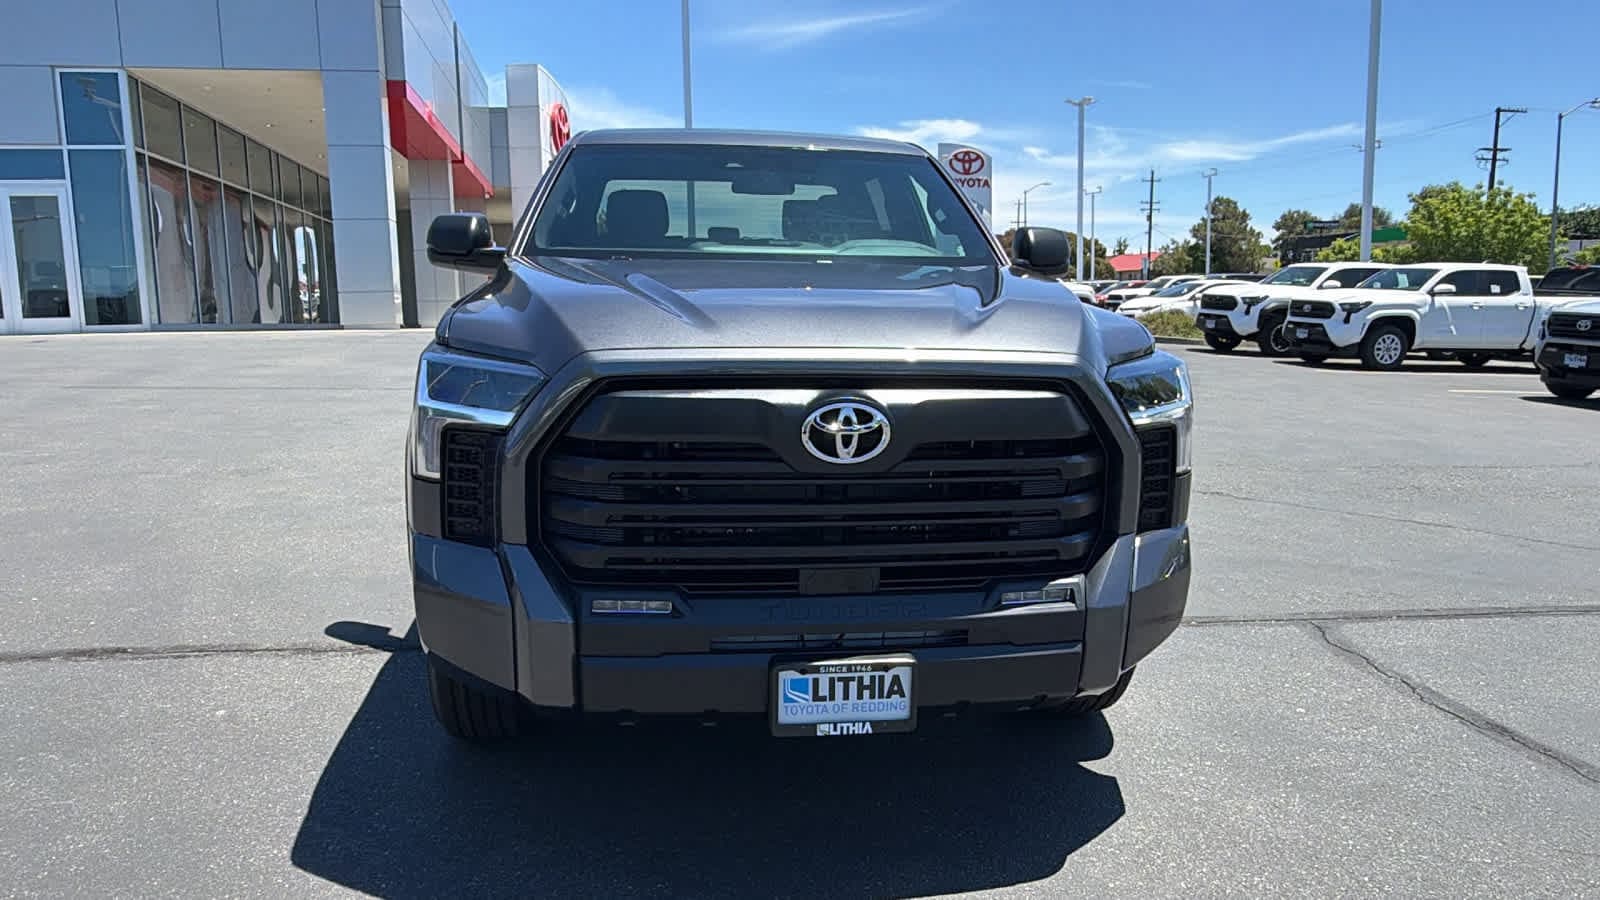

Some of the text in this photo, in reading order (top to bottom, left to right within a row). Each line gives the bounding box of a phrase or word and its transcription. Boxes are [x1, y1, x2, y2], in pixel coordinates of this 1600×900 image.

[955, 177, 990, 188] YOTA
[819, 665, 848, 673] SINCE
[812, 675, 906, 702] LITHIA
[783, 699, 907, 716] TOYOTA OF REDDING
[829, 721, 873, 735] LITHIA
